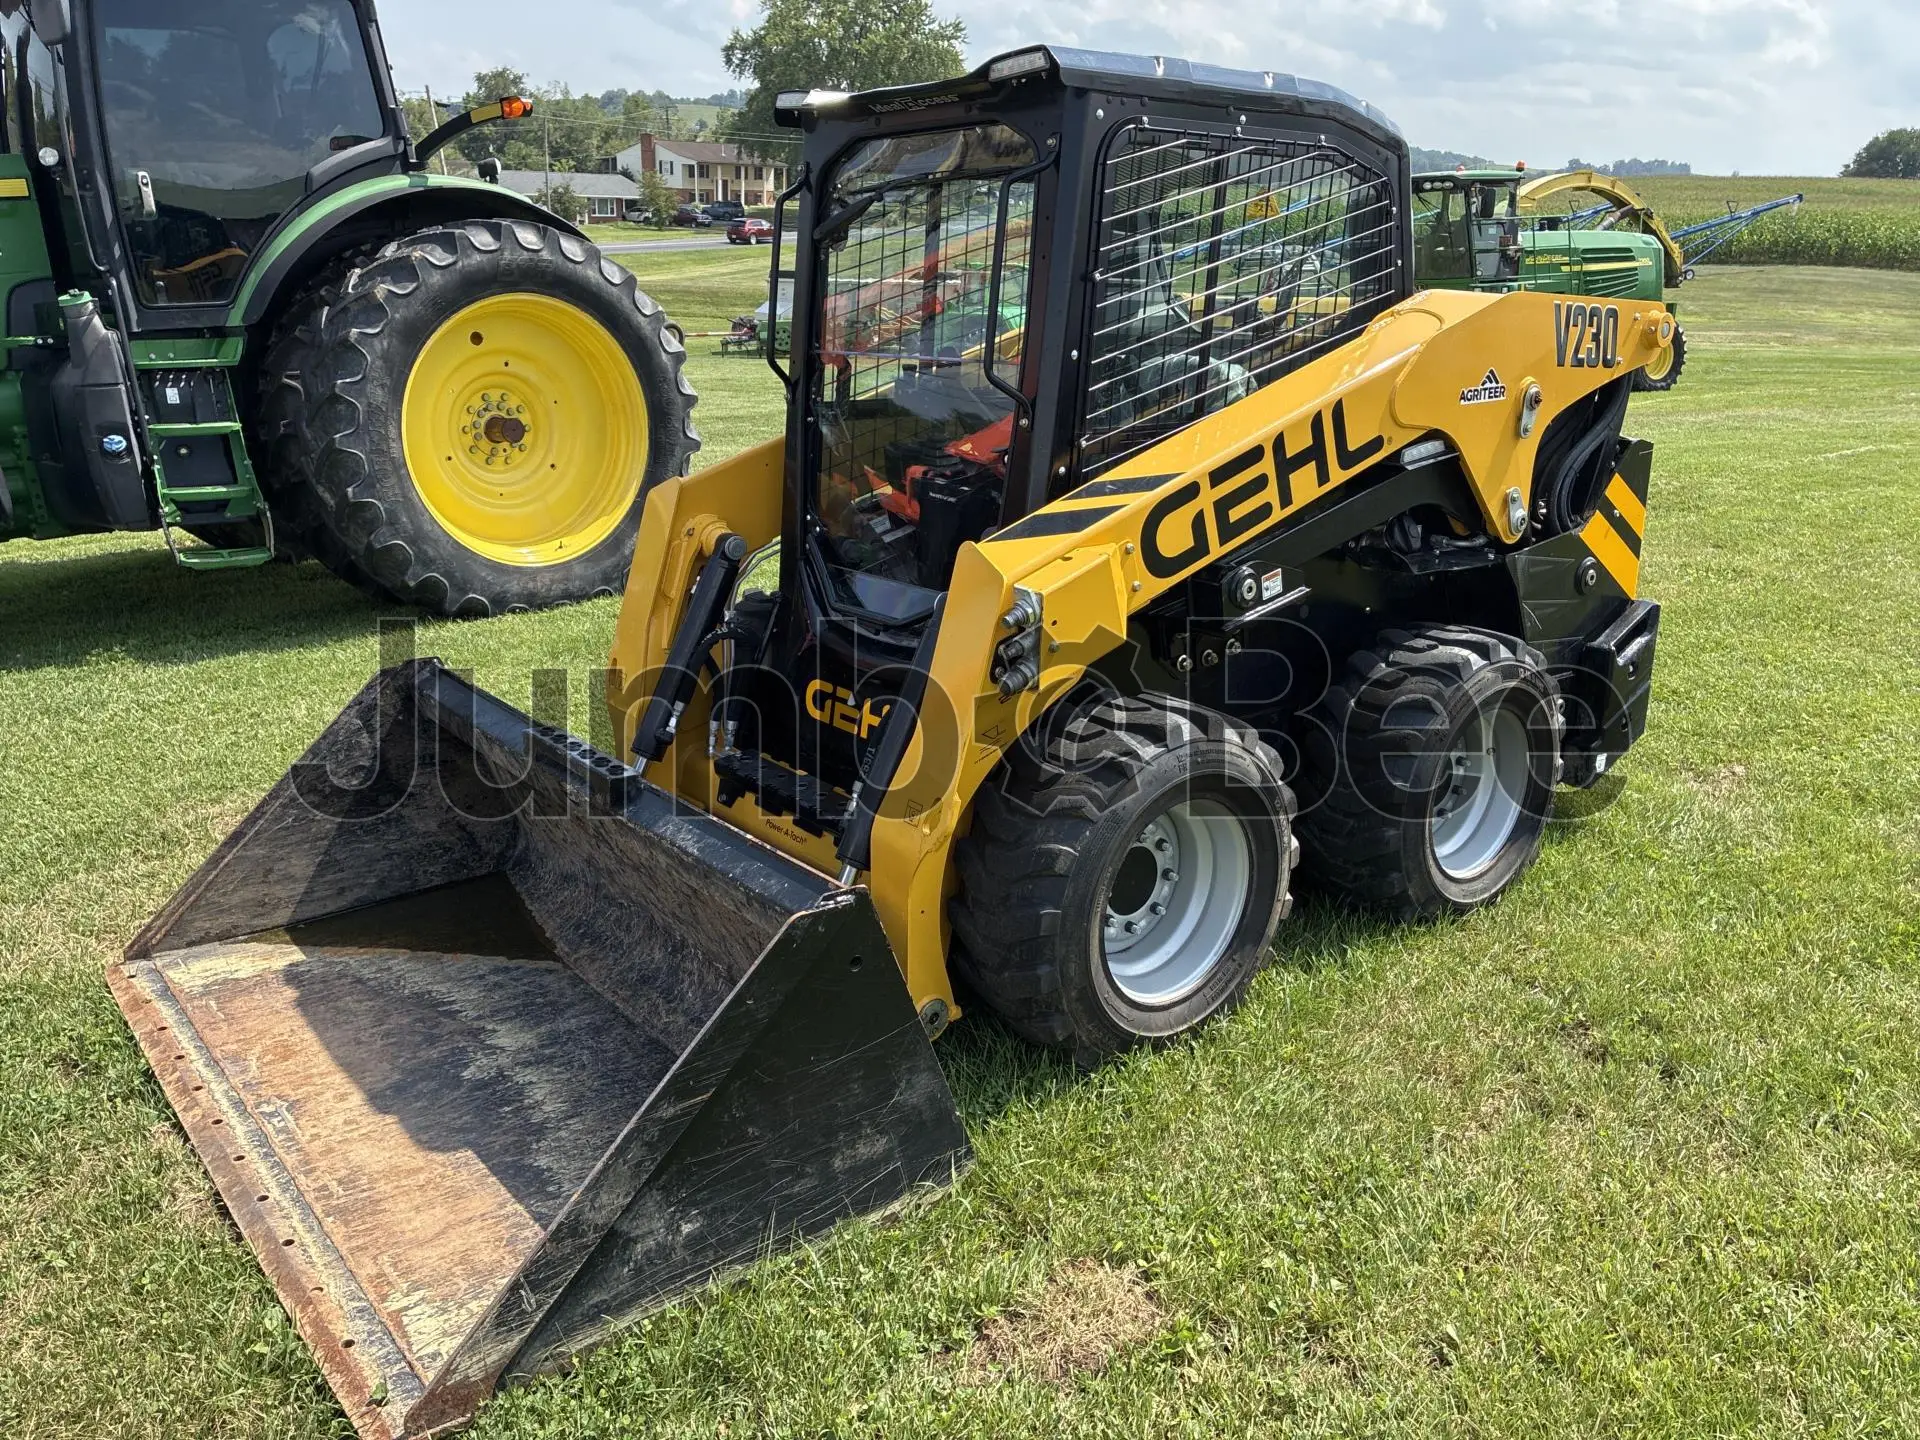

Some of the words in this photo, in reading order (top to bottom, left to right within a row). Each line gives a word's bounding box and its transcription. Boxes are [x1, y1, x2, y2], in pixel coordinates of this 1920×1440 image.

[1554, 301, 1619, 368] V230
[1459, 385, 1506, 402] AGRITEER
[1140, 397, 1384, 579] GEHL
